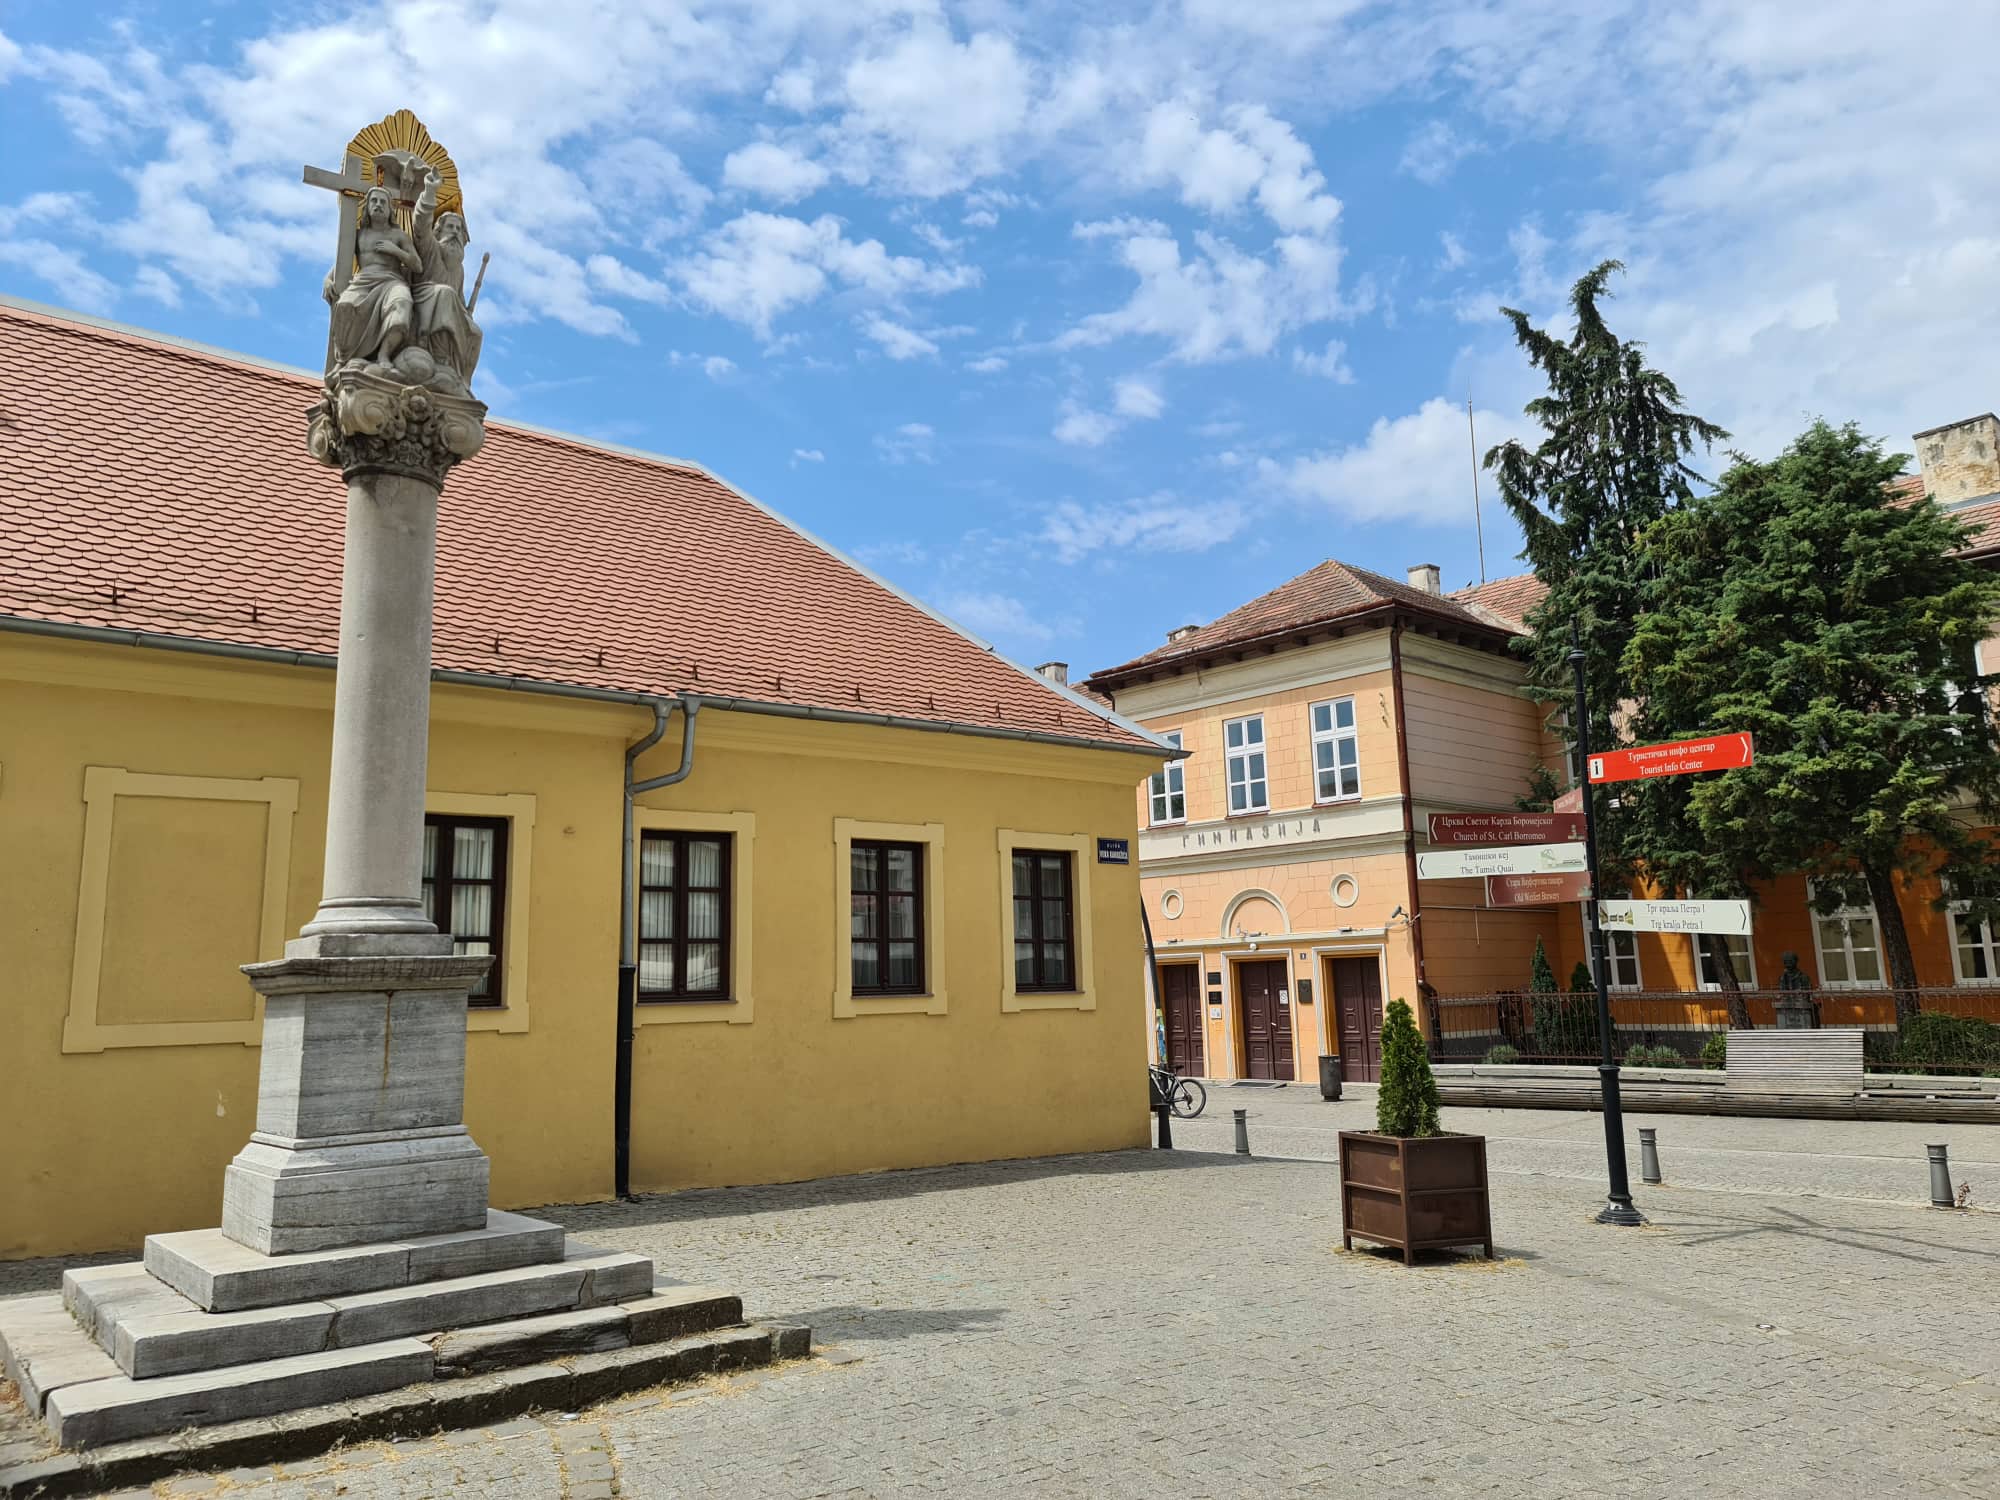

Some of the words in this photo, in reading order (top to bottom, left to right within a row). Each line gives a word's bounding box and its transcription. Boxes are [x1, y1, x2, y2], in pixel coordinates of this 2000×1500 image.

[1628, 750, 1668, 764] Туристички
[1669, 747, 1688, 758] инфо
[1689, 743, 1715, 753] центар
[1640, 765, 1663, 775] Tourist
[1664, 763, 1678, 773] Info
[1680, 760, 1704, 770] Center
[1441, 816, 1464, 828] Црква
[1465, 816, 1489, 826] Светог
[1491, 816, 1511, 828] Карла
[1182, 818, 1320, 848] ГИМНАЗИЈА
[1453, 832, 1478, 841] Church
[1479, 832, 1487, 840] of
[1488, 832, 1497, 841] St.
[1498, 832, 1512, 841] Carl
[1514, 832, 1546, 841] Borromeo
[1461, 866, 1473, 874] The
[1497, 864, 1514, 875] Quai
[1646, 904, 1657, 914] Трг
[1681, 904, 1701, 914] Петра
[1651, 920, 1662, 930] Trg
[1682, 920, 1699, 929] Petra
